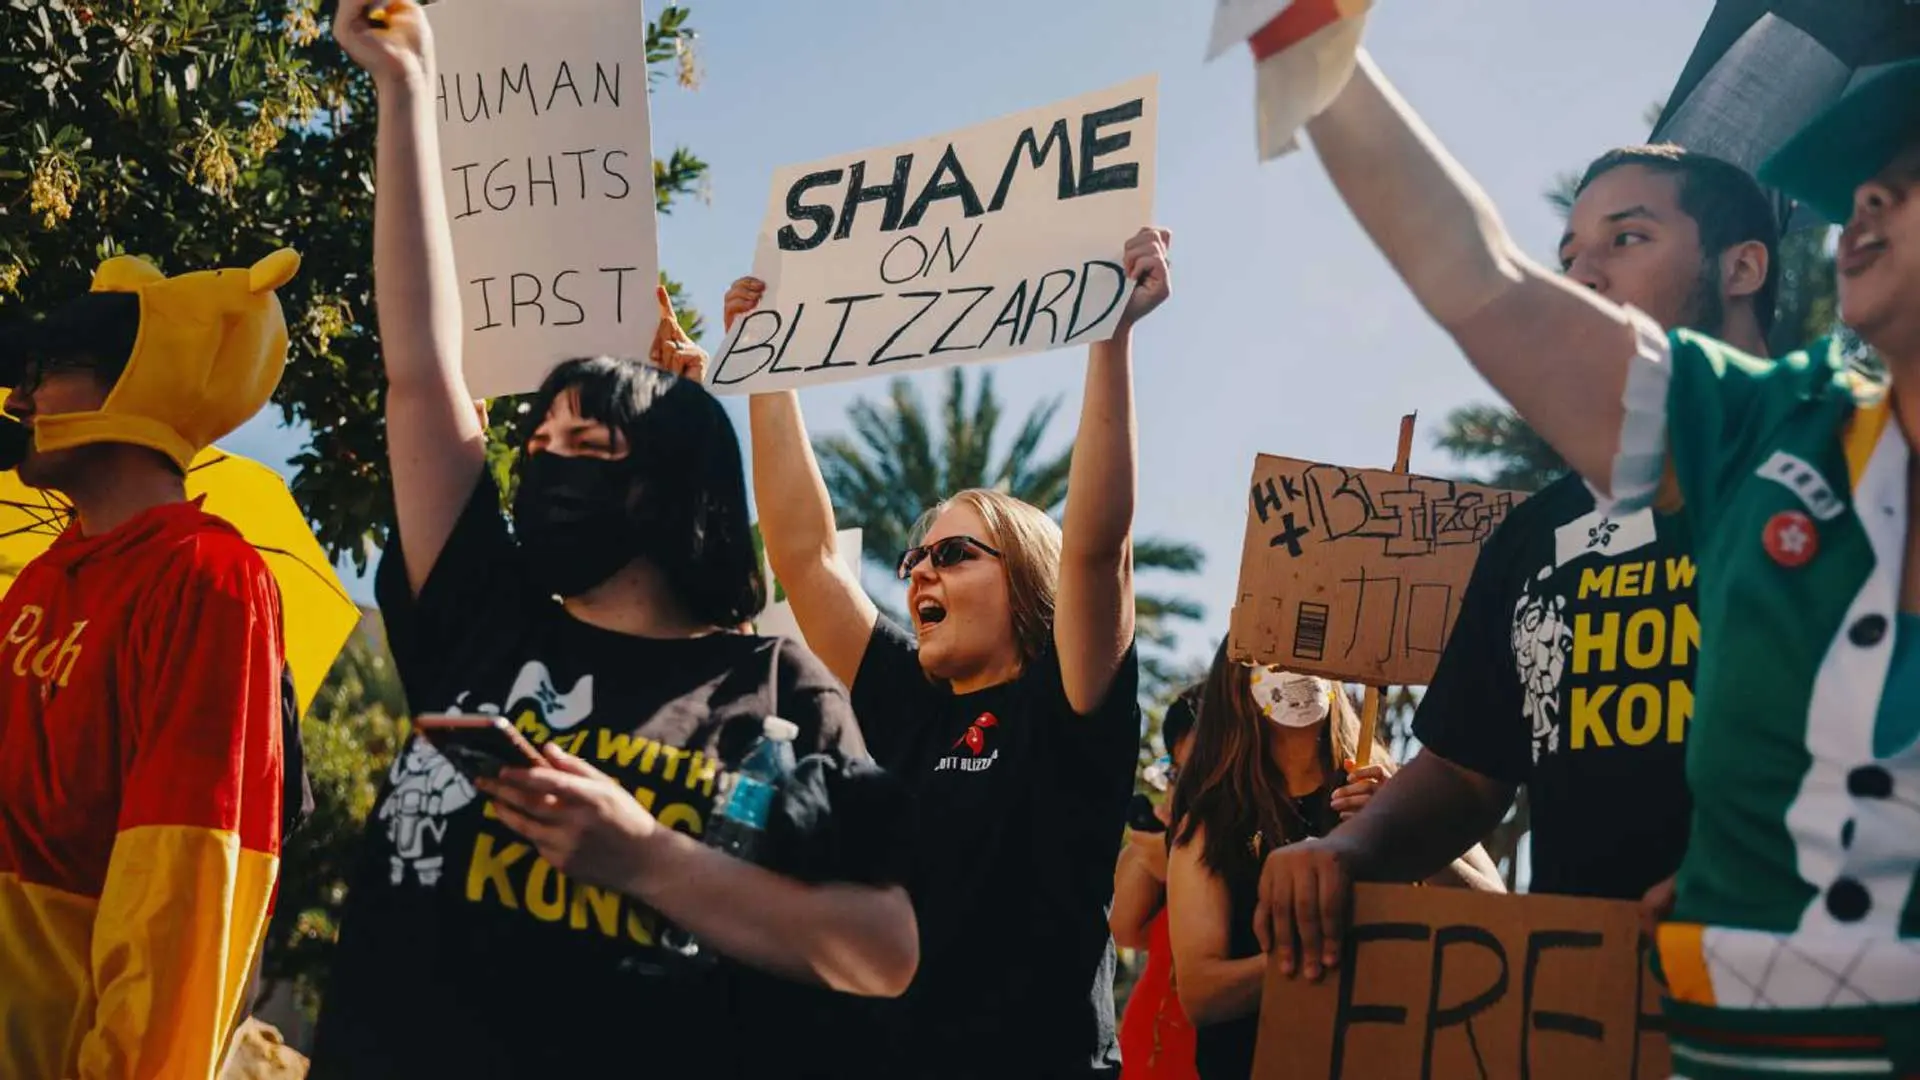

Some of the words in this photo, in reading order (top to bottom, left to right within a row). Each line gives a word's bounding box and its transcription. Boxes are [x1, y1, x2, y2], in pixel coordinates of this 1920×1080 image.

[452, 149, 629, 219] IGHTS
[777, 97, 1144, 251] SHAME
[879, 223, 983, 284] ON
[470, 267, 637, 331] IRST
[712, 260, 1126, 385] BLIZZARD
[1577, 560, 1656, 599] MEI
[1572, 603, 1701, 674] HON
[1570, 680, 1695, 750] KON
[597, 727, 716, 797] WITH
